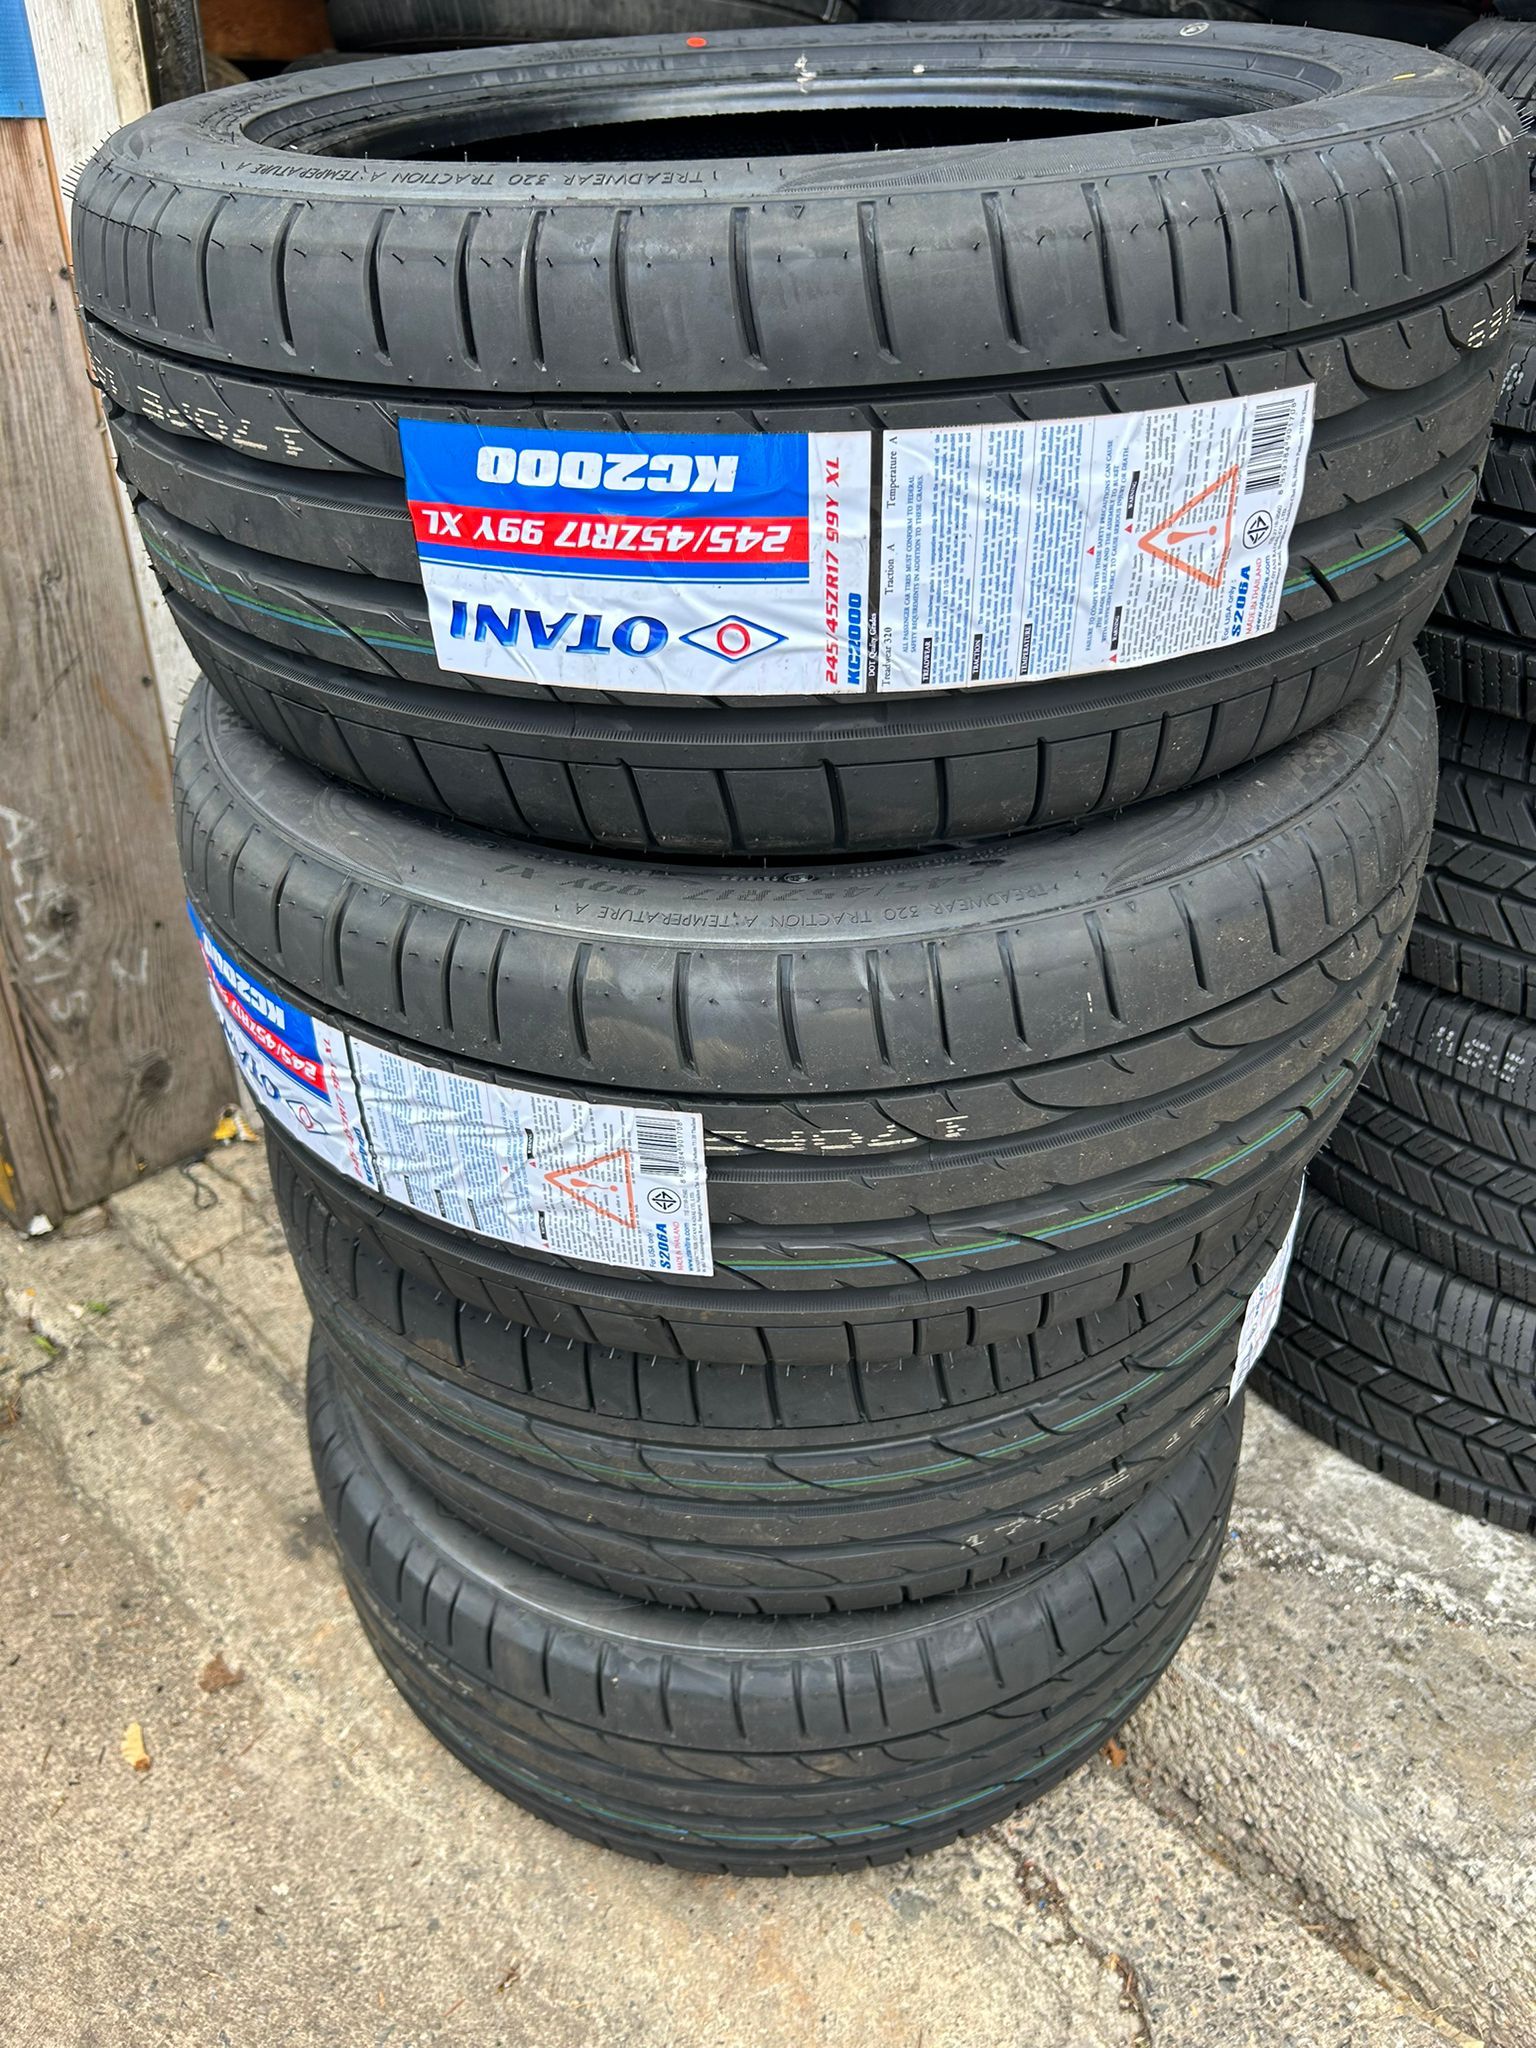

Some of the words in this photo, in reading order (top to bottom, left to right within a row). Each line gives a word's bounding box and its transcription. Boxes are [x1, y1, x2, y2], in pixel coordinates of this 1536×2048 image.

[253, 163, 360, 182] TEMPERATURE
[371, 171, 386, 183] A
[391, 172, 495, 185] TRACTION
[508, 173, 550, 186] 320
[562, 171, 703, 185] TREADWEAR
[1285, 403, 1296, 441] 901708
[889, 436, 898, 444] A
[1105, 439, 1113, 462] CAUSE
[477, 446, 739, 494] KC2000
[826, 457, 839, 487] XL
[887, 451, 899, 509] Temperature
[1104, 463, 1112, 478] CAN
[1099, 480, 1110, 524] PRECAUTIONS
[1110, 488, 1117, 497] TO
[826, 494, 839, 543] 99Y
[907, 505, 914, 515] TO
[421, 508, 463, 540] XL
[473, 516, 545, 545] 99Y
[915, 527, 922, 536] TO
[555, 521, 792, 553] 245/45ZR17
[886, 544, 895, 552] A
[885, 559, 895, 595] Traction
[1251, 558, 1262, 599] THAILAND
[1227, 586, 1236, 603] only
[1231, 565, 1251, 637] S206A
[1249, 601, 1257, 609] IN
[825, 550, 839, 685] 245/45ZR17
[869, 613, 877, 635] Grades
[1223, 605, 1232, 625] USA
[1245, 610, 1256, 635] MADE
[450, 601, 669, 658] OTANI
[847, 592, 861, 685] KC2000
[882, 627, 893, 644] 320
[1221, 628, 1229, 641] For
[868, 638, 878, 659] Quality
[973, 639, 981, 673] TRACTION
[1021, 626, 1031, 673] TEMPERATURE
[868, 660, 876, 677] DOT
[881, 645, 893, 686] Treadwear
[923, 641, 931, 681] TREADWEAR
[575, 903, 588, 915] A
[929, 885, 1049, 915] TREADWEAR
[598, 906, 729, 928] TEMPERATURE
[743, 914, 758, 927] A
[771, 912, 872, 928] TRACTION
[884, 905, 919, 921] 320
[202, 932, 286, 1030] KC2000
[647, 1231, 655, 1244] only
[656, 1223, 671, 1269] S206A
[648, 1245, 656, 1257] USA
[649, 1258, 657, 1268] For
